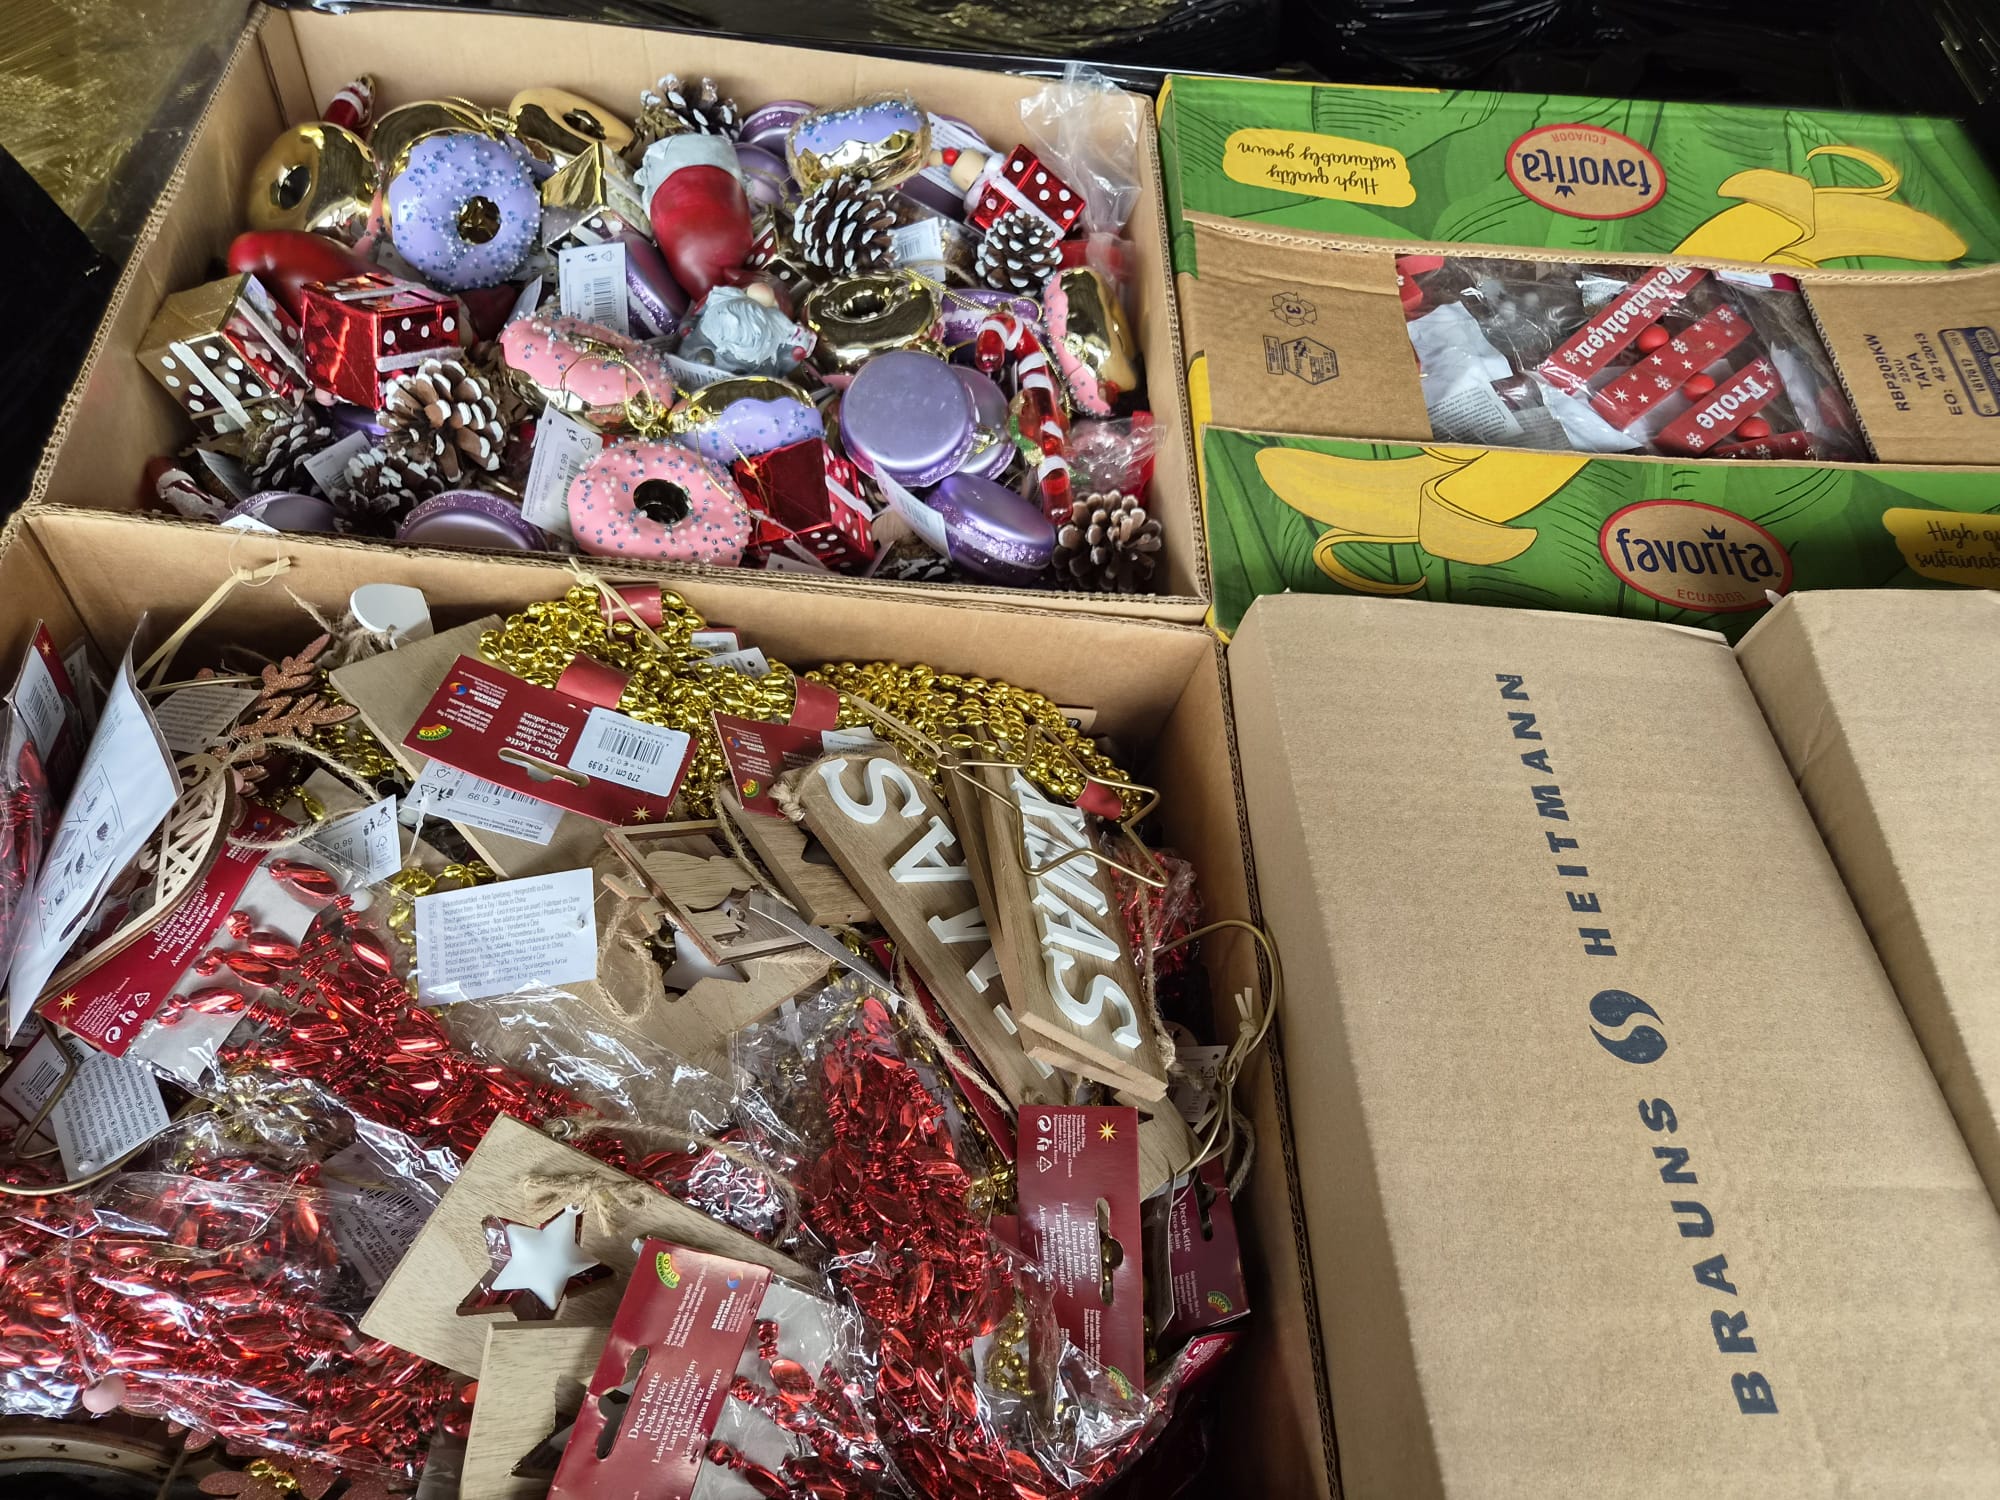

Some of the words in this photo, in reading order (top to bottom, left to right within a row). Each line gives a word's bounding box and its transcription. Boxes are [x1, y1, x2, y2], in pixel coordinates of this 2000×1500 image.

[1236, 136, 1295, 160] grown
[1550, 129, 1607, 147] ECUADOR
[1265, 160, 1330, 189] quality
[1298, 145, 1396, 175] sustainably
[1518, 145, 1654, 197] favorita
[1332, 168, 1380, 195] High
[1574, 262, 1692, 361] Weihnachten
[1863, 333, 1911, 411] RBP209KW
[1893, 360, 1911, 383] 22XU
[1907, 352, 1932, 389] TAPA
[1914, 333, 1946, 382] 4212013
[1693, 374, 1768, 434] Frohe
[1944, 389, 1962, 415] EO:
[1923, 518, 1979, 550] High
[1613, 528, 1777, 584] favorita
[1676, 586, 1745, 605] ECUADOR
[518, 716, 566, 739] Deco-ketting
[522, 711, 569, 733] Deco-cadena
[504, 735, 559, 761] Deco-Kette
[514, 730, 557, 750] Deco-chain
[615, 768, 626, 777] cm
[626, 771, 640, 782] 270
[492, 798, 500, 806] €
[1493, 673, 1618, 957] HEITMANN
[175, 924, 187, 936] de
[1057, 1234, 1064, 1244] de
[1070, 1221, 1078, 1253] Ukrasni
[1175, 1202, 1194, 1252] Deco-Kette
[1087, 1221, 1098, 1282] Deco-Kette
[1634, 1092, 1780, 1418] BRAUNS
[662, 1254, 681, 1280] DECO
[1064, 1247, 1074, 1298] dekoracyjny
[669, 1358, 699, 1414] dekoracyjny
[627, 1370, 663, 1440] Deco-Kette
[650, 1403, 669, 1441] Ukrasni
[674, 1415, 684, 1427] de
